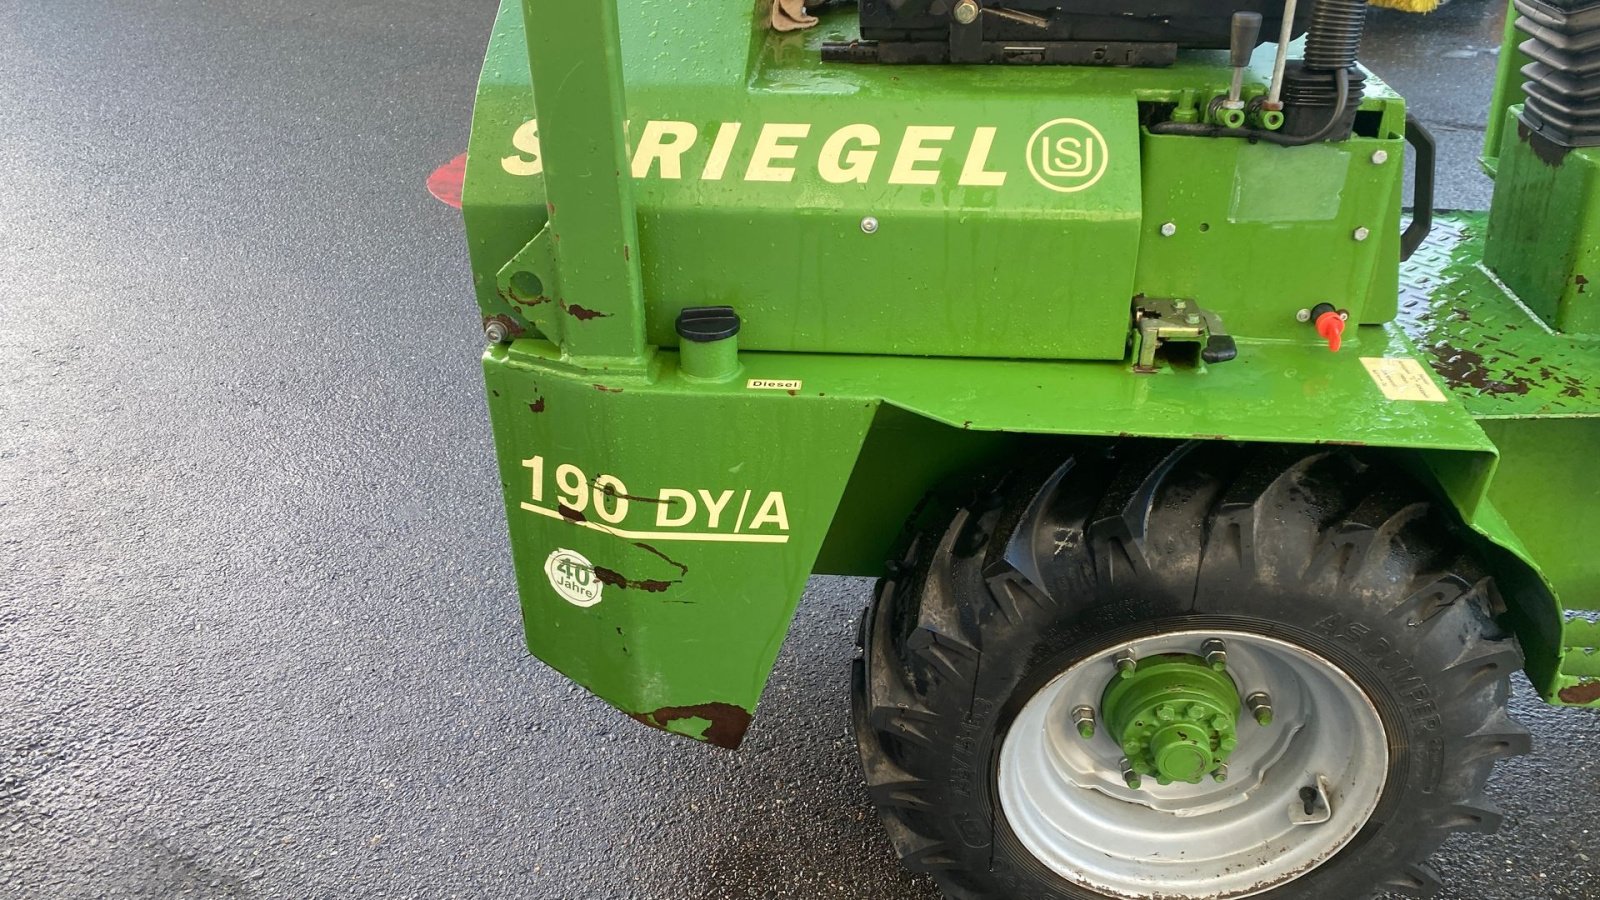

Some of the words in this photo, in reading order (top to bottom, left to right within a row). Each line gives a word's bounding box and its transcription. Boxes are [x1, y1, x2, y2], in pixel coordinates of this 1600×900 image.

[501, 119, 1007, 187] SRIEGEL
[752, 380, 798, 388] Diesel
[521, 455, 629, 524] 190
[655, 488, 790, 533] DY/A
[557, 558, 590, 586] 40
[557, 576, 593, 598] Jahre
